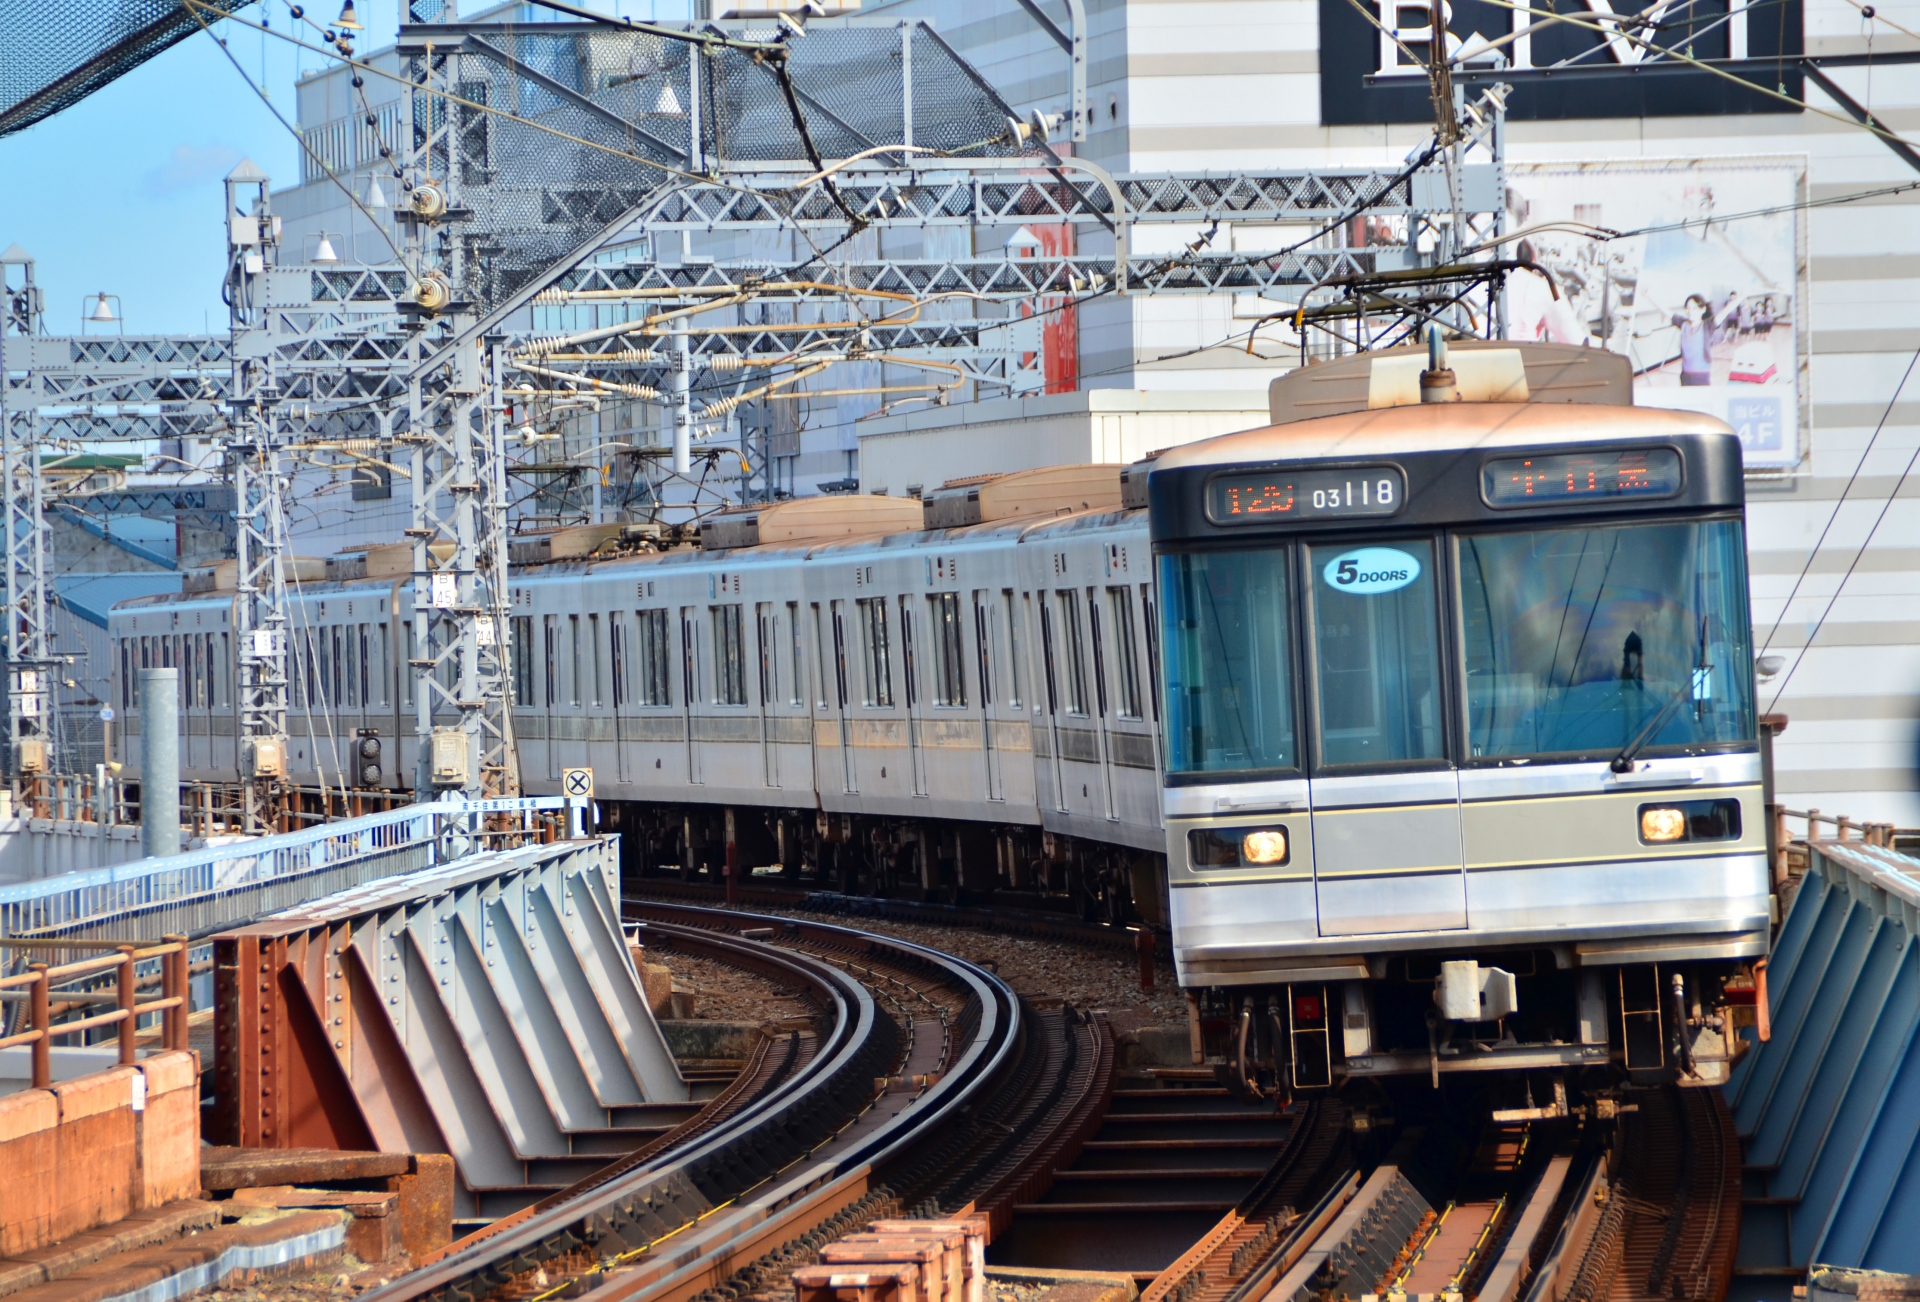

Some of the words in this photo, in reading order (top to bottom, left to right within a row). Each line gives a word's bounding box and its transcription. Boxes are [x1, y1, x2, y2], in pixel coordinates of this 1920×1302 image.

[1737, 422, 1774, 445] 4F
[1313, 479, 1393, 508] 03118
[1336, 559, 1358, 585] 5
[1358, 570, 1408, 584] DOORS
[436, 590, 452, 604] 45
